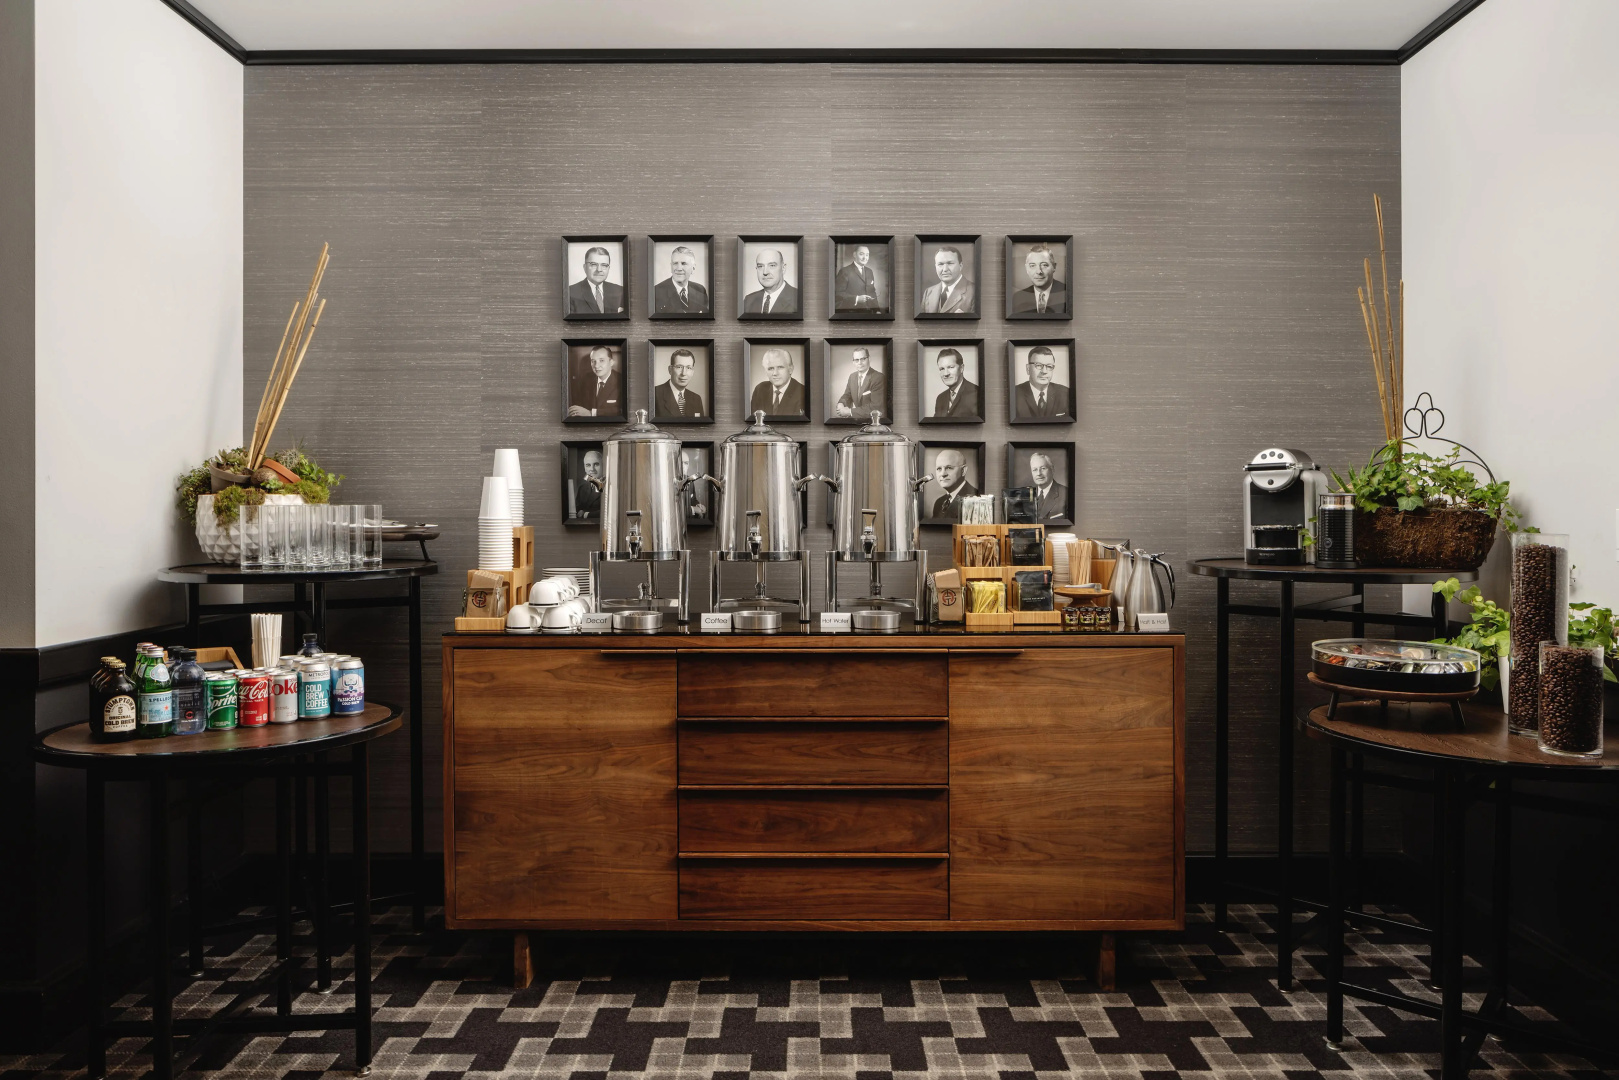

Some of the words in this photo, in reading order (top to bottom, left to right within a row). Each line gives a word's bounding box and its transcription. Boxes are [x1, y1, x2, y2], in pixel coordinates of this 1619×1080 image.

[305, 684, 322, 693] COLD
[305, 691, 325, 700] BREW
[105, 697, 135, 713] STUMPTOWN
[208, 695, 237, 709] Sprite
[305, 698, 328, 707] COFFEE
